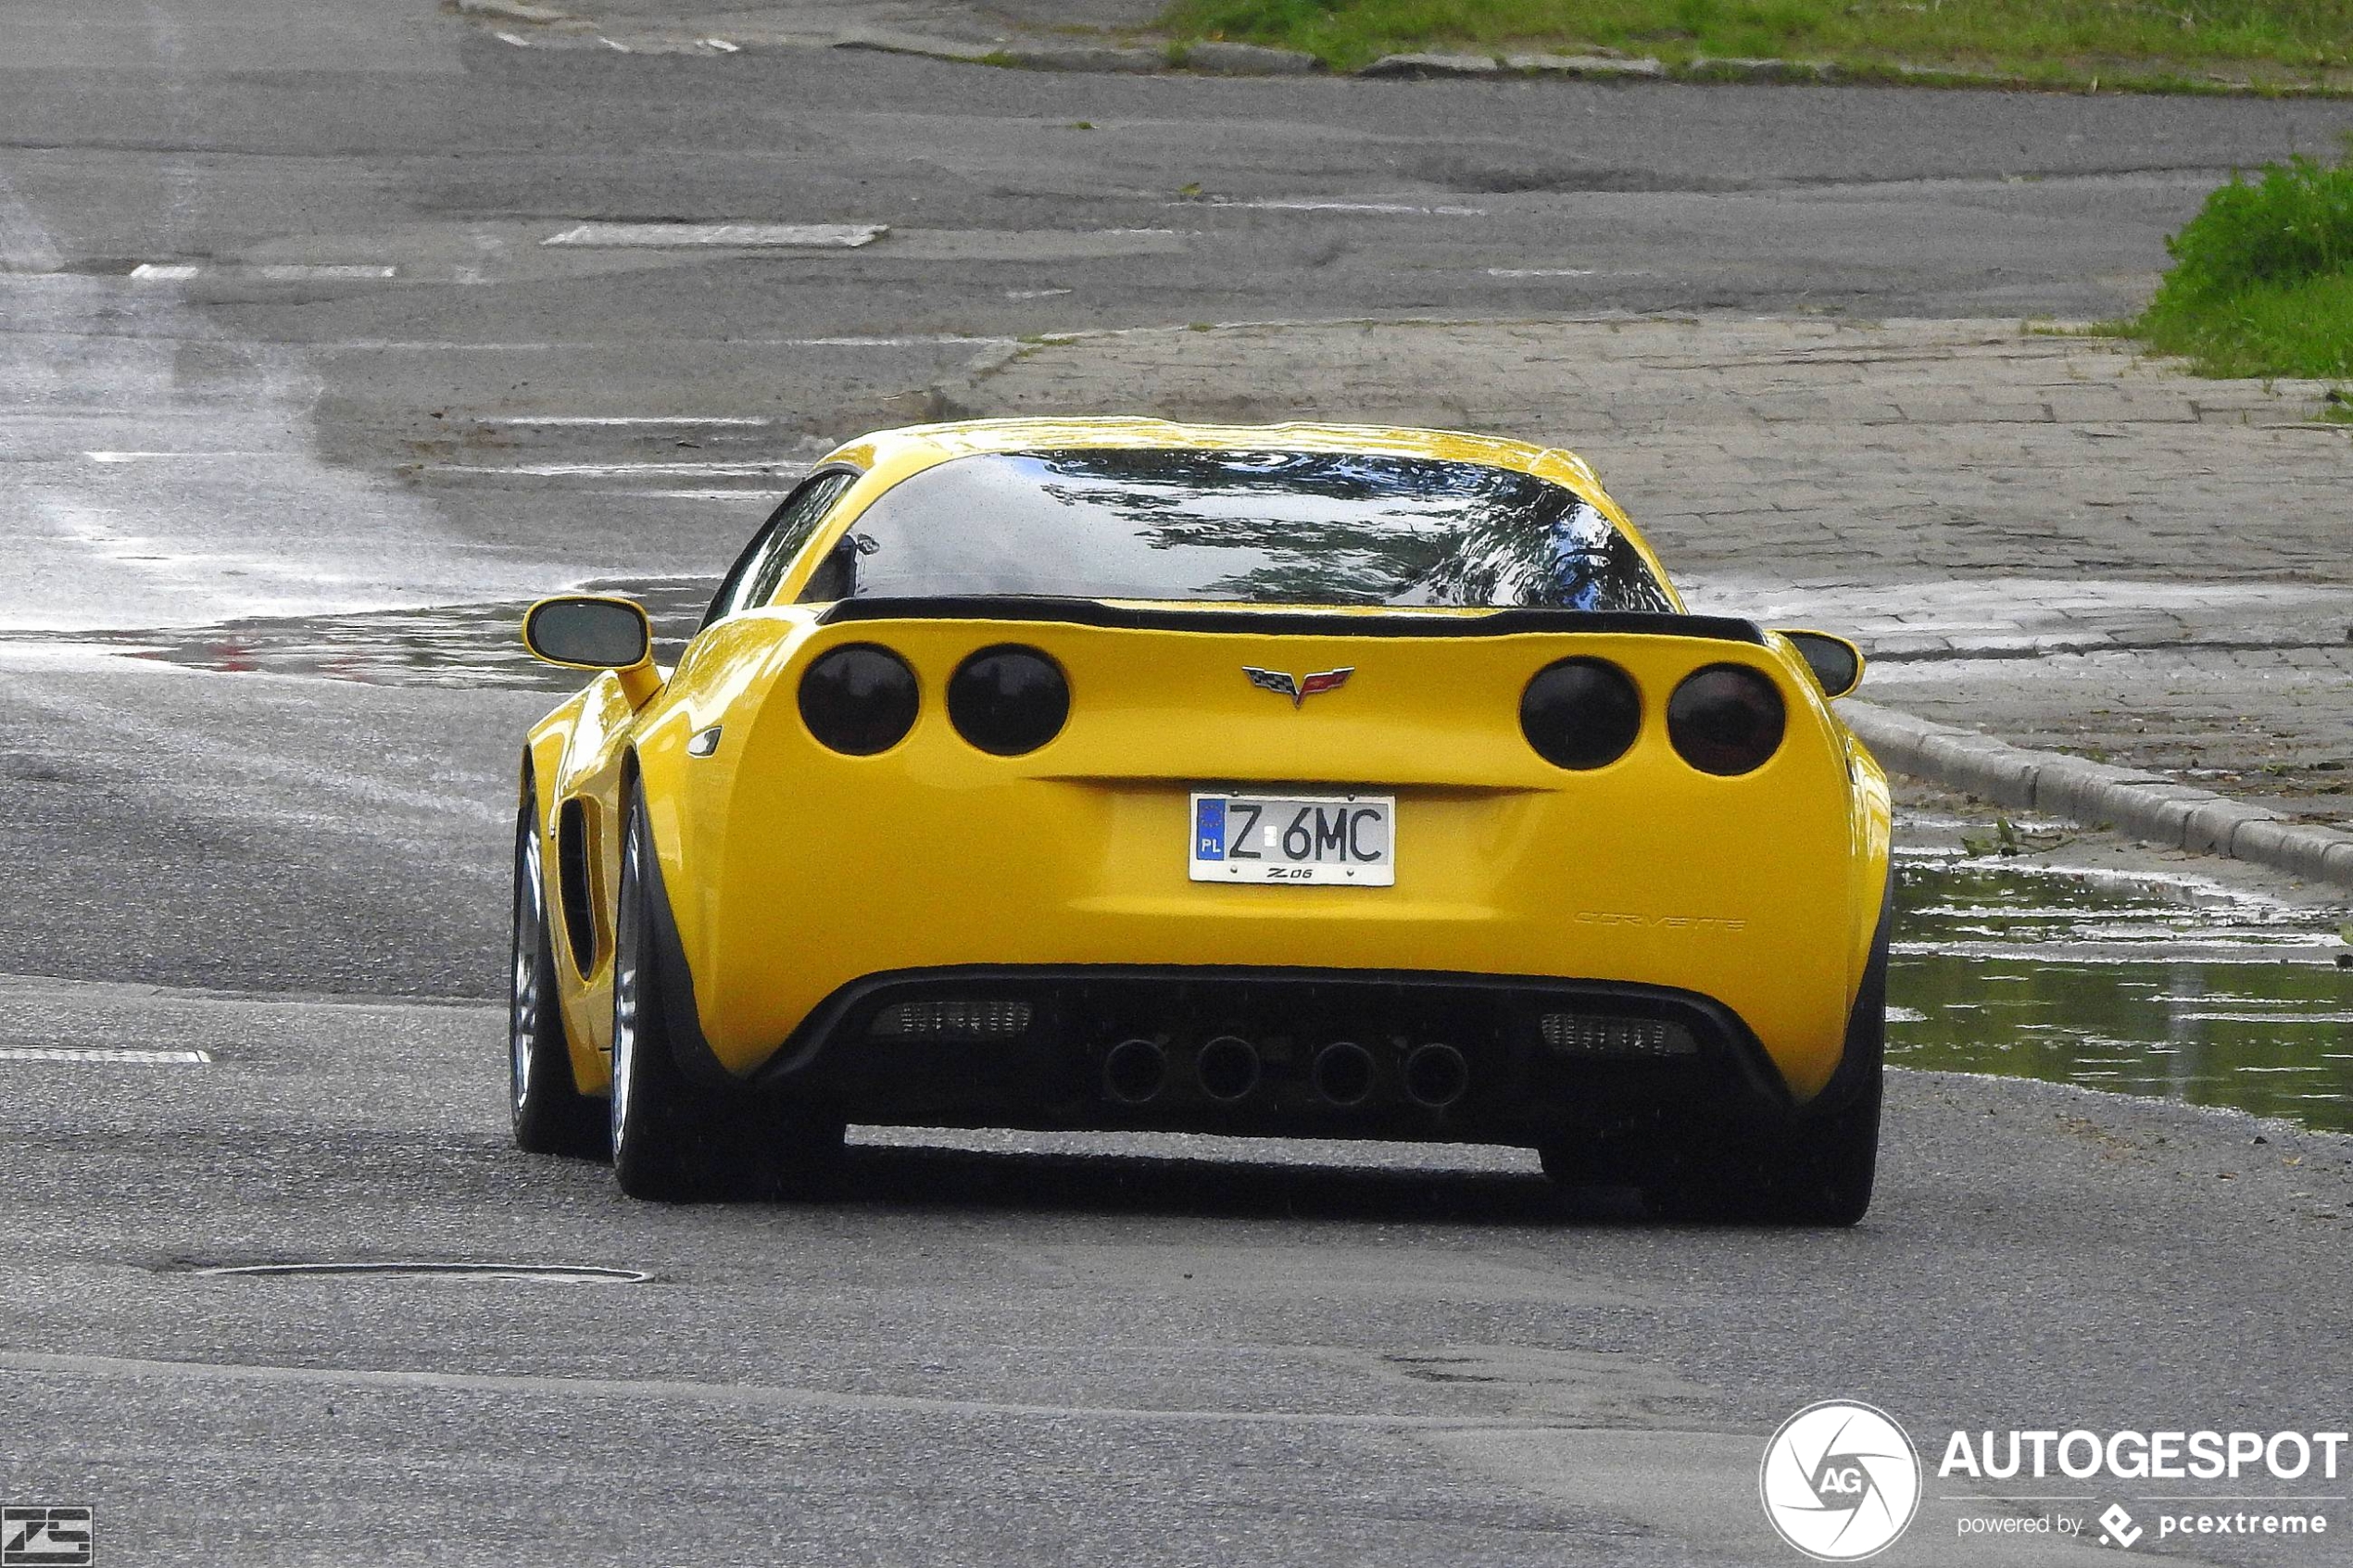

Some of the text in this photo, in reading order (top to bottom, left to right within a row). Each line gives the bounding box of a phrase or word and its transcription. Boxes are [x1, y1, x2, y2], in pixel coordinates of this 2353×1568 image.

[1229, 805, 1382, 861] Z 6MC
[1201, 838, 1221, 853] PL
[1266, 867, 1313, 878] Z06
[1575, 911, 1747, 932] CORVETTE
